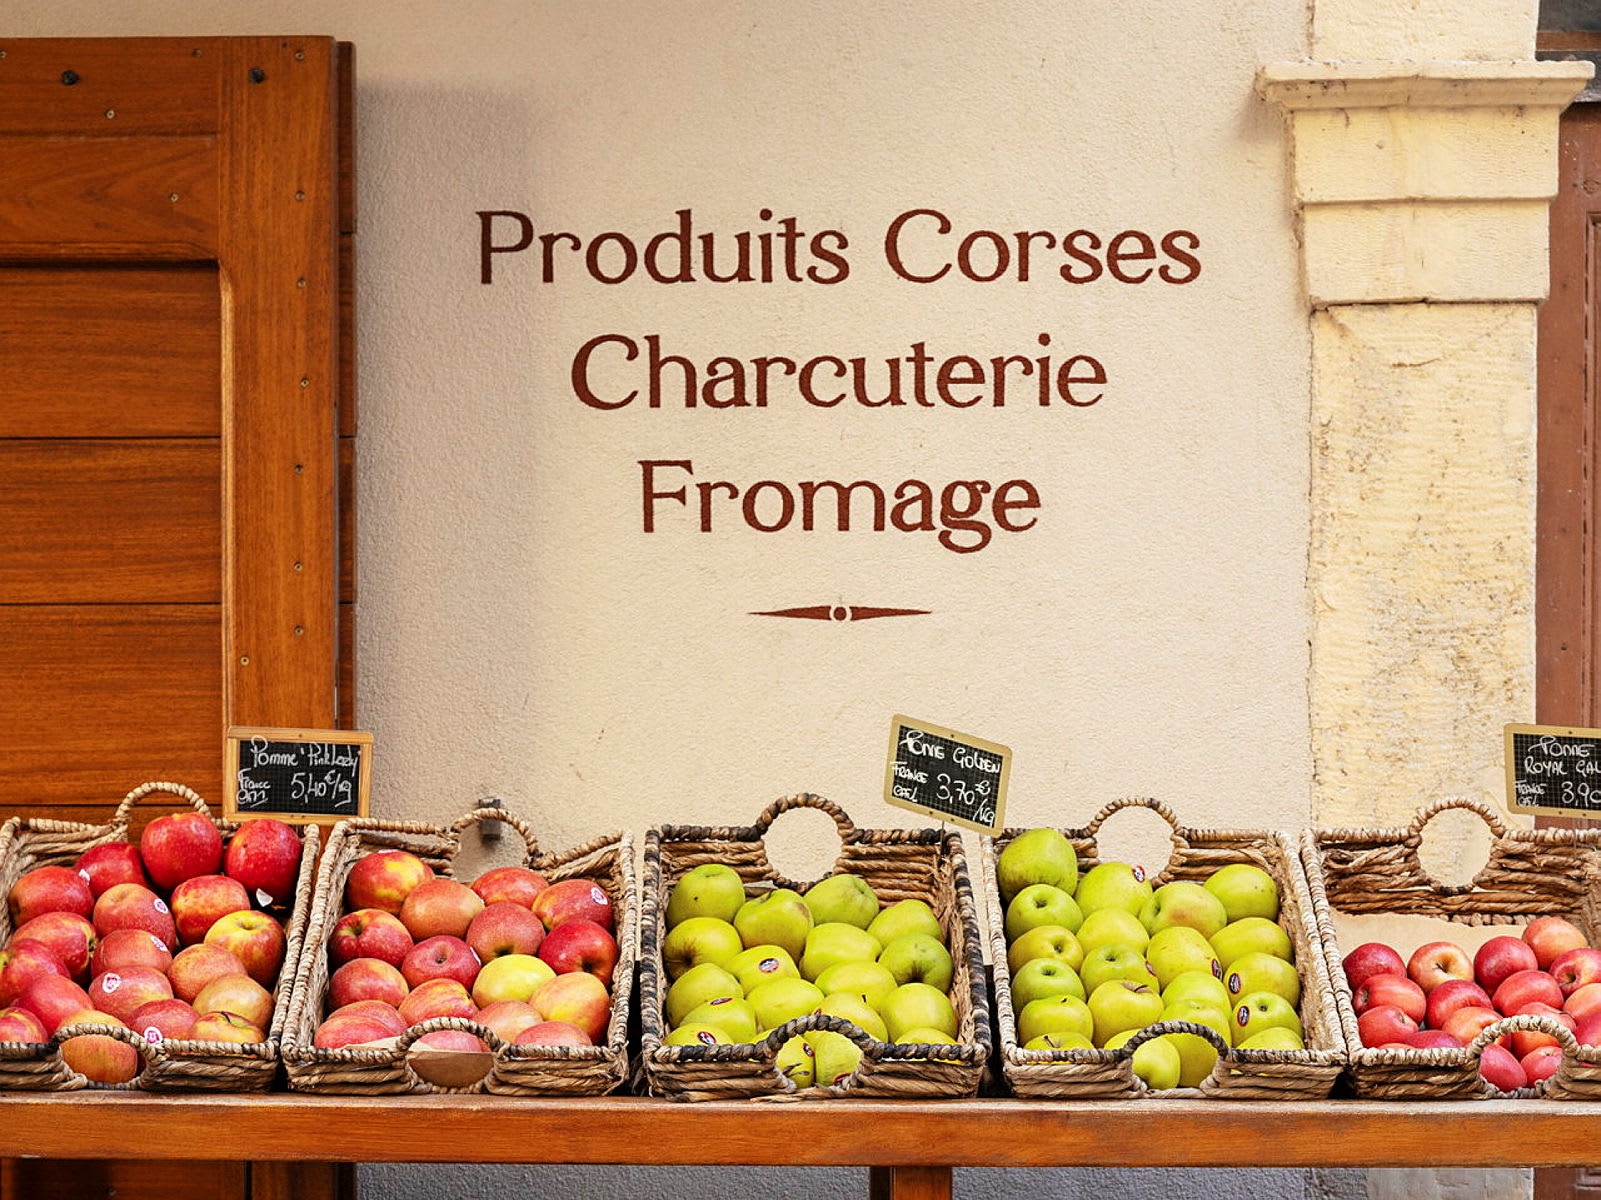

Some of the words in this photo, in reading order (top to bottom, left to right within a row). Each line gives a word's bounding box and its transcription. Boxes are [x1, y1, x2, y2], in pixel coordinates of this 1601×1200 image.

[476, 208, 851, 285] Produits
[884, 208, 1202, 285] Corses
[570, 333, 1108, 411] Charcuterie
[637, 459, 1042, 554] Fromage
[250, 735, 299, 768] Pomme
[1524, 755, 1568, 778] ROYAL
